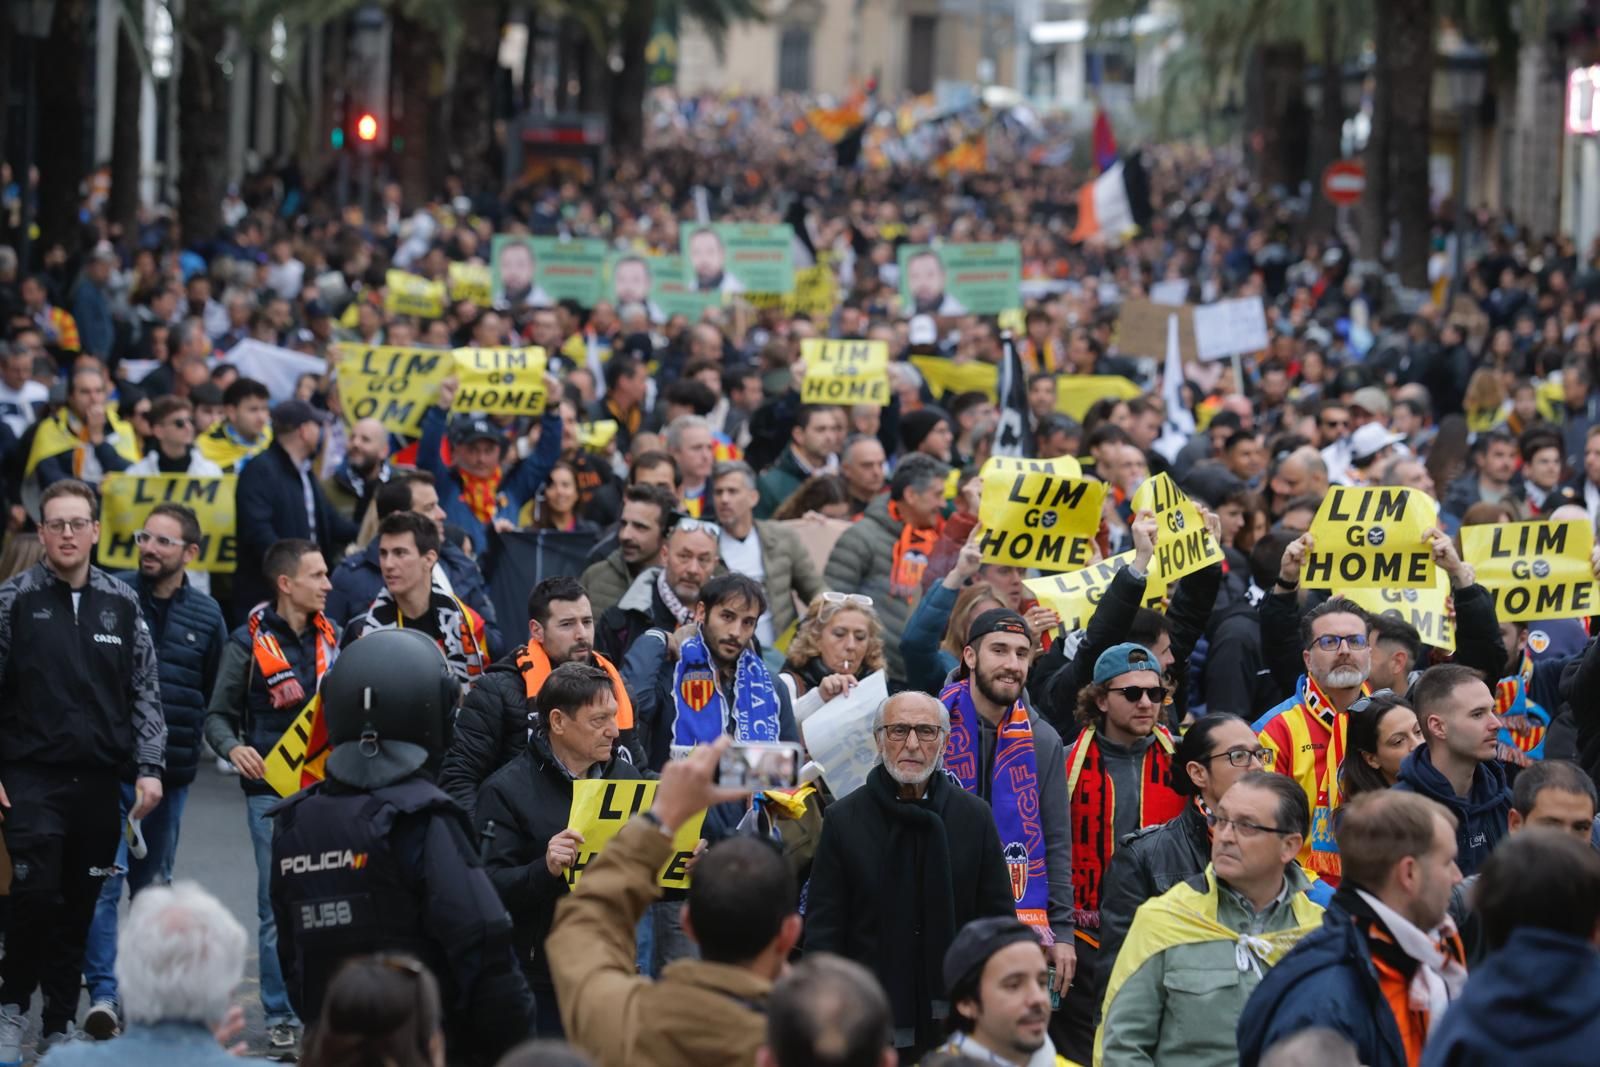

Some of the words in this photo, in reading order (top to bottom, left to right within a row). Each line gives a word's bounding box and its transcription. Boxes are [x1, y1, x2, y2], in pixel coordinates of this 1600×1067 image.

[361, 351, 441, 376] LIM
[475, 353, 527, 369] LIM
[821, 344, 869, 362] LIM
[457, 390, 543, 410] HOME
[807, 381, 885, 400] HOME
[134, 479, 221, 504] LIM
[1008, 474, 1089, 510] LIM
[1327, 490, 1411, 522] LIM
[980, 528, 1089, 565] HOME
[1159, 527, 1216, 579] HOME
[1491, 523, 1569, 558] LIM
[1055, 556, 1128, 593] LIM
[1305, 552, 1430, 583] HOME
[280, 848, 355, 877] POLICIA
